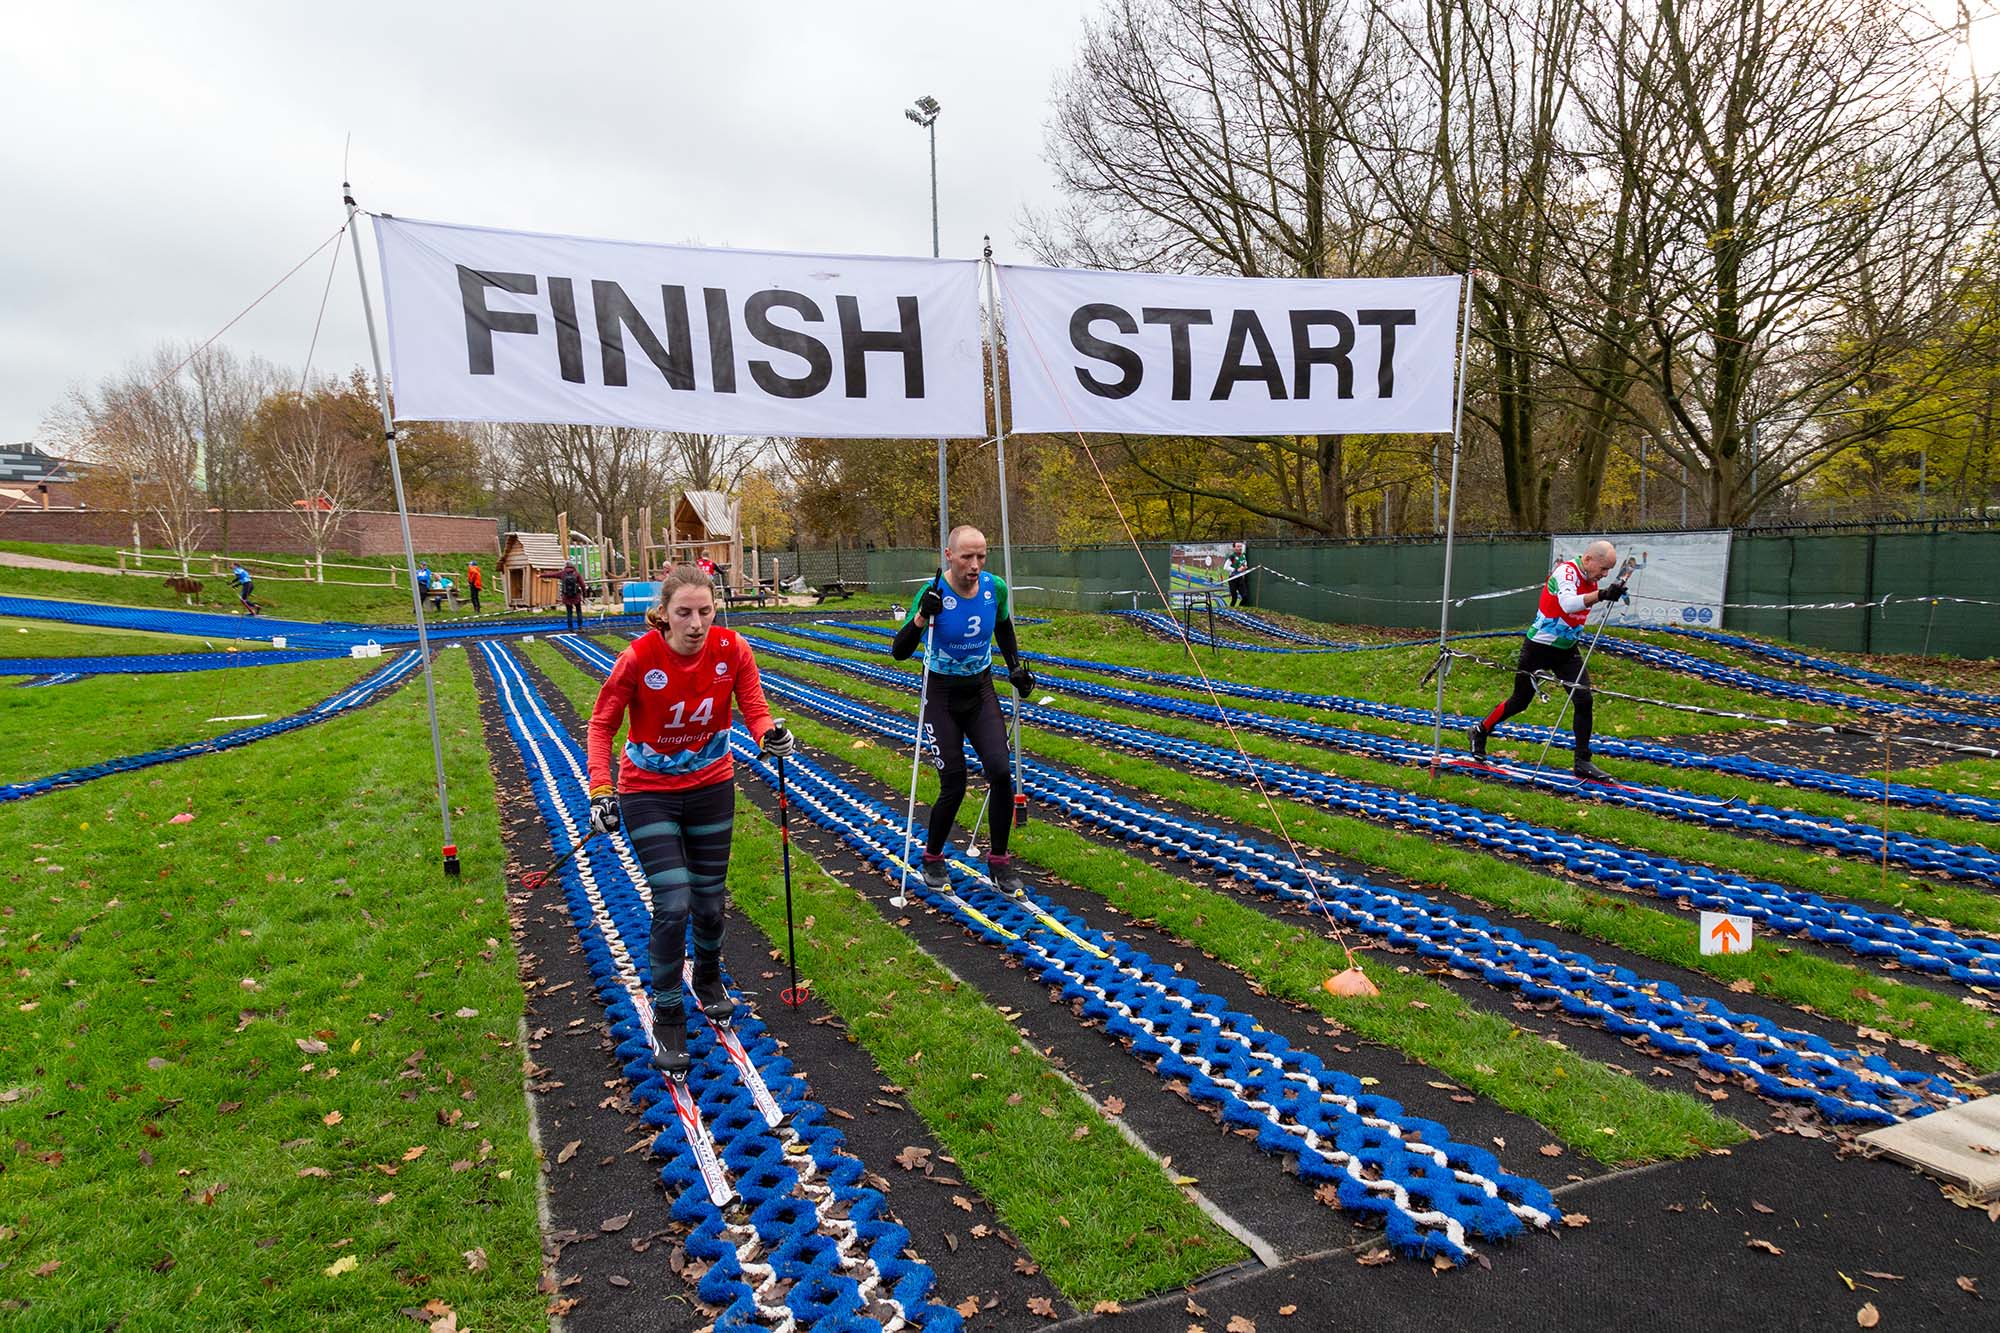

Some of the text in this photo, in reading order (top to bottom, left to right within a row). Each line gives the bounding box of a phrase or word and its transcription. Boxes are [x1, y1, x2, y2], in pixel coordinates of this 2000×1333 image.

[456, 263, 924, 399] FINISH
[1069, 303, 1417, 401] START
[964, 615, 981, 638] 3
[664, 697, 714, 729] 14
